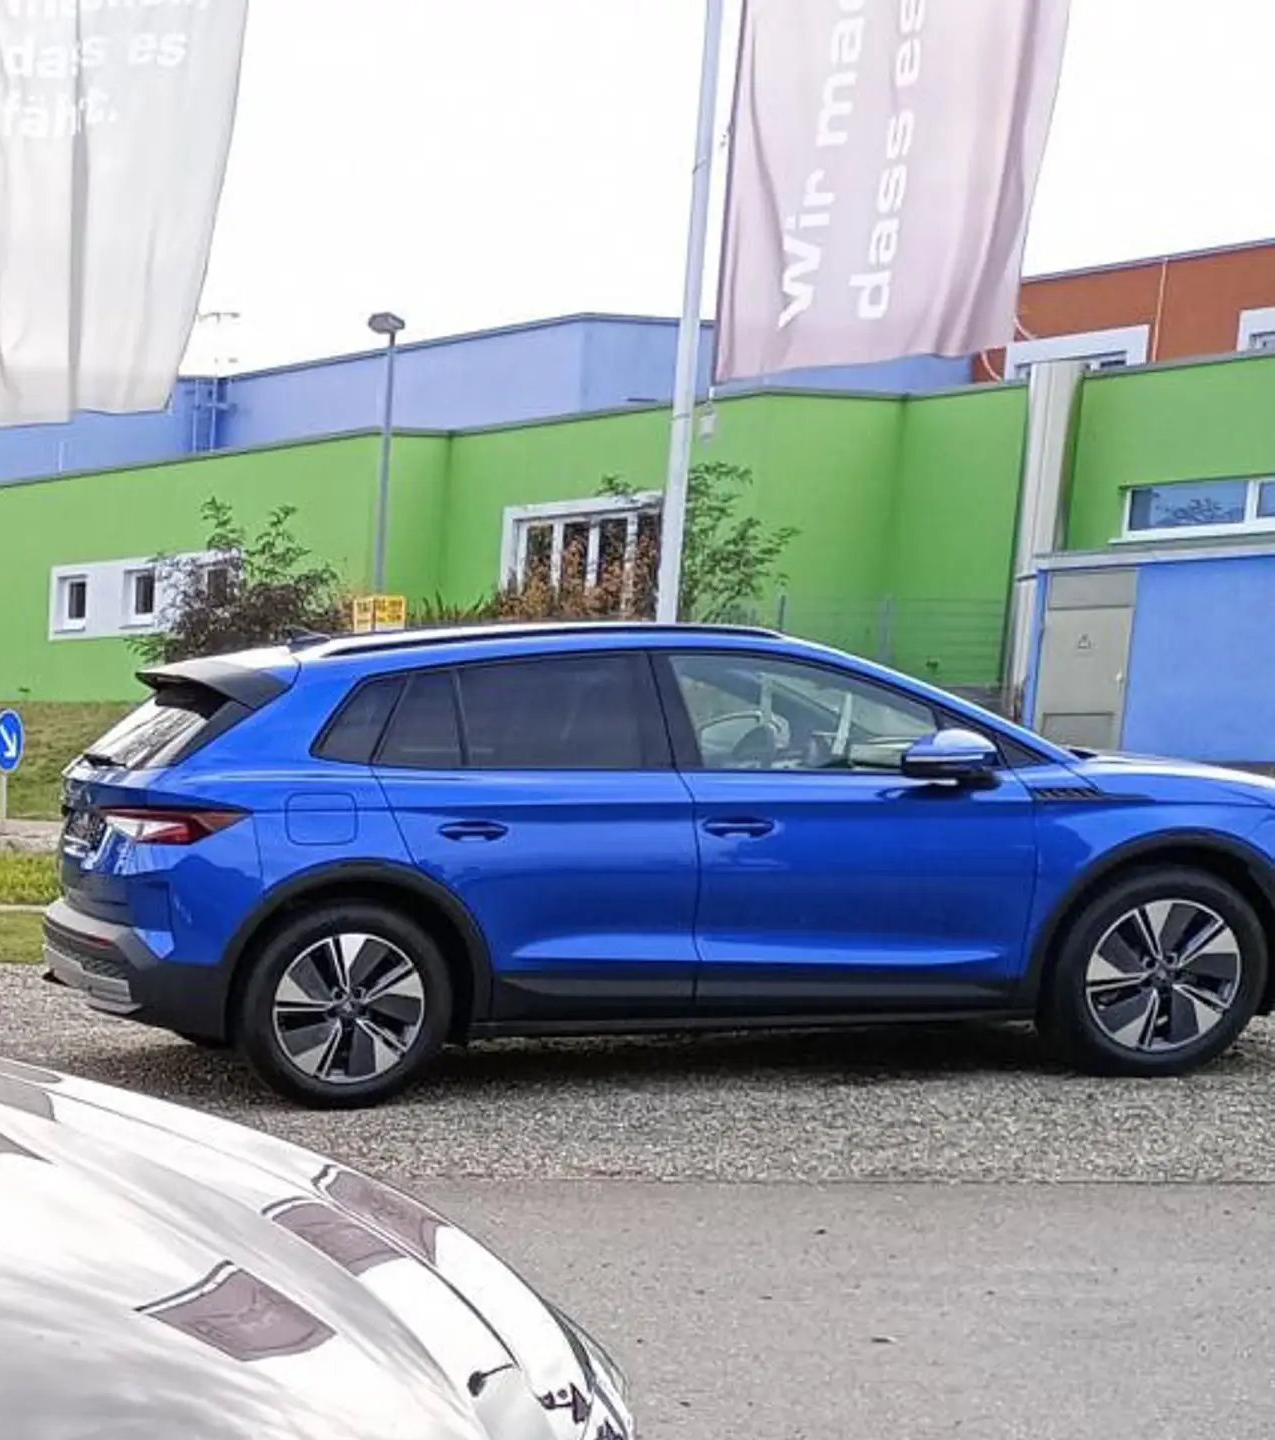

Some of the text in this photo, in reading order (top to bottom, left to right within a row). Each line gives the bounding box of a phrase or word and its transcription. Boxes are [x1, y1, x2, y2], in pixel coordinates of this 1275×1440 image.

[4, 32, 188, 79] das es
[1, 87, 118, 137] fäht.
[850, 0, 925, 319] dass es
[778, 168, 836, 330] Wir
